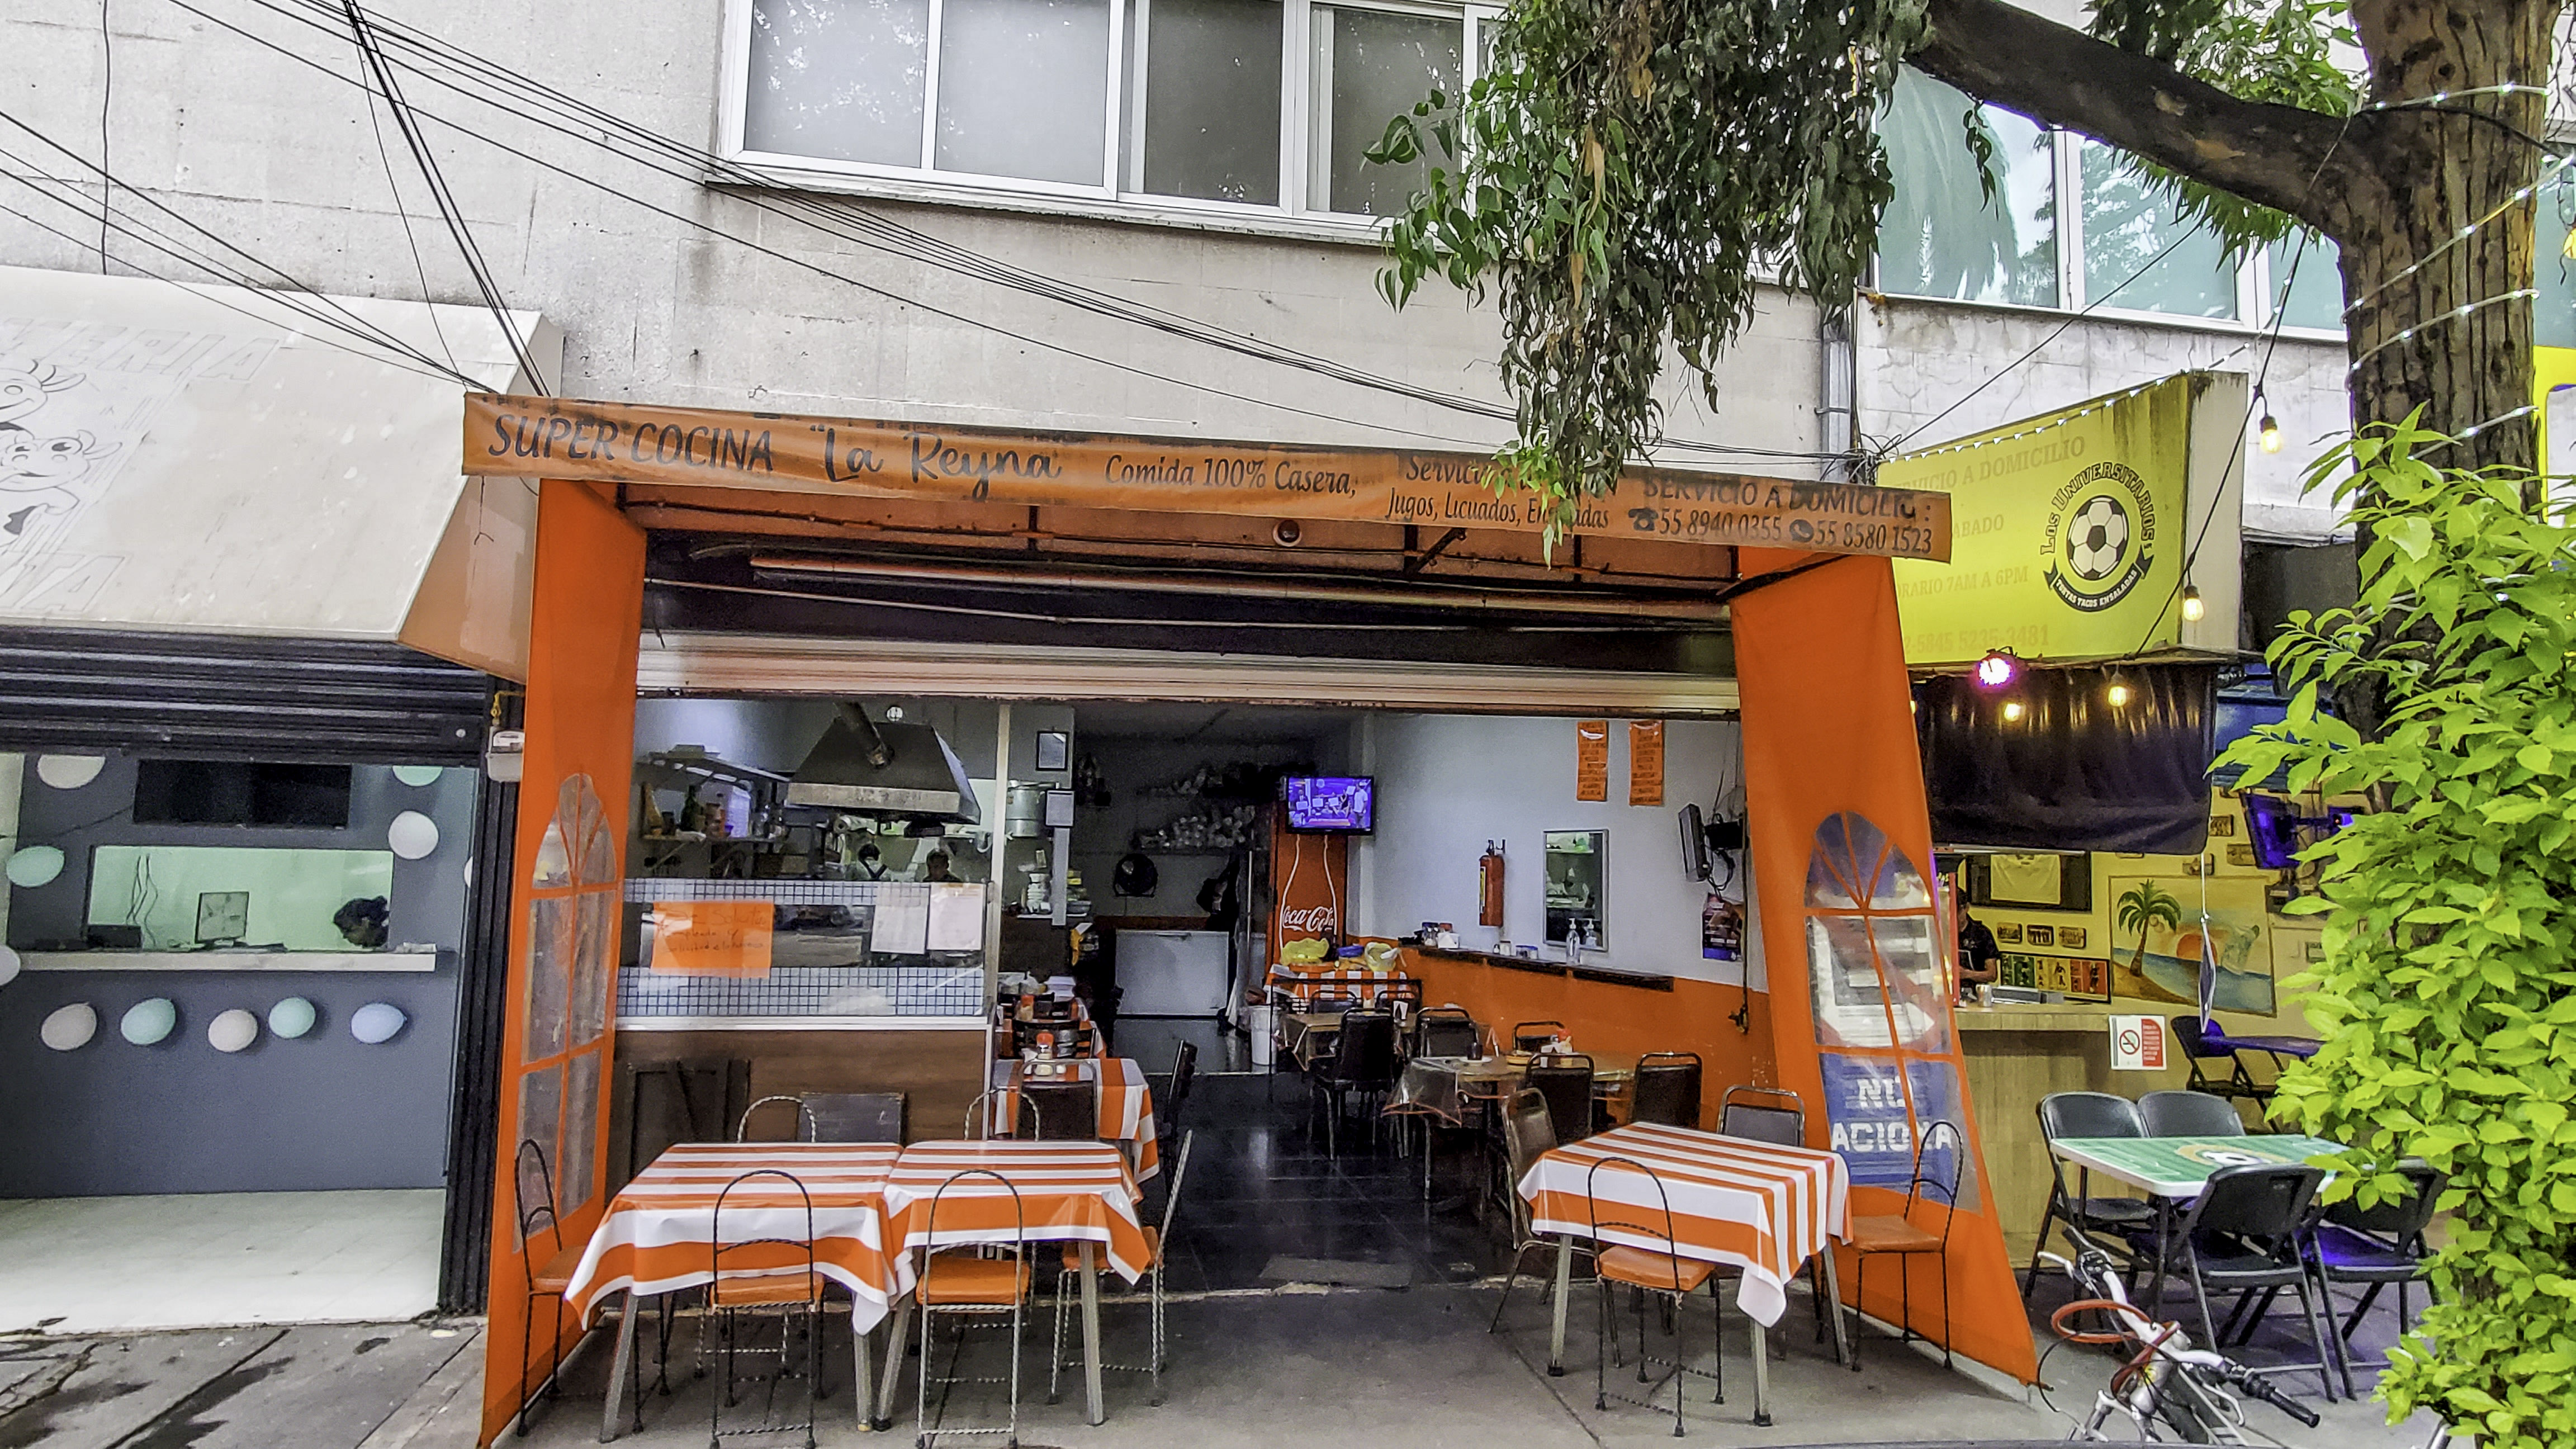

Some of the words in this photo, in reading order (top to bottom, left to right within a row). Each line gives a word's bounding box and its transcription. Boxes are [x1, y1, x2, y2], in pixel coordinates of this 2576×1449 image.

[489, 414, 618, 461] SUPER
[632, 423, 773, 472] COCINA
[903, 430, 1062, 502] Reyna
[1106, 454, 1194, 486] Comida
[1204, 458, 1266, 488] 100%
[1275, 461, 1356, 497] Casera,
[1980, 435, 2085, 480] DOMICILIO
[1385, 487, 1438, 523] Jugos,
[1445, 491, 1521, 527] Licuados,
[1644, 477, 1758, 505] SERVICIO
[1765, 485, 1781, 508] A
[1659, 508, 1682, 534] 55
[1687, 509, 1733, 538] 8940
[1737, 514, 1782, 541] 0355
[1815, 520, 1837, 546] 55
[1843, 522, 1887, 550] 8580
[1891, 525, 1932, 554] 1523
[1947, 573, 1977, 592] 7AM
[1981, 571, 1992, 588] A
[1995, 566, 2029, 585] 6PM
